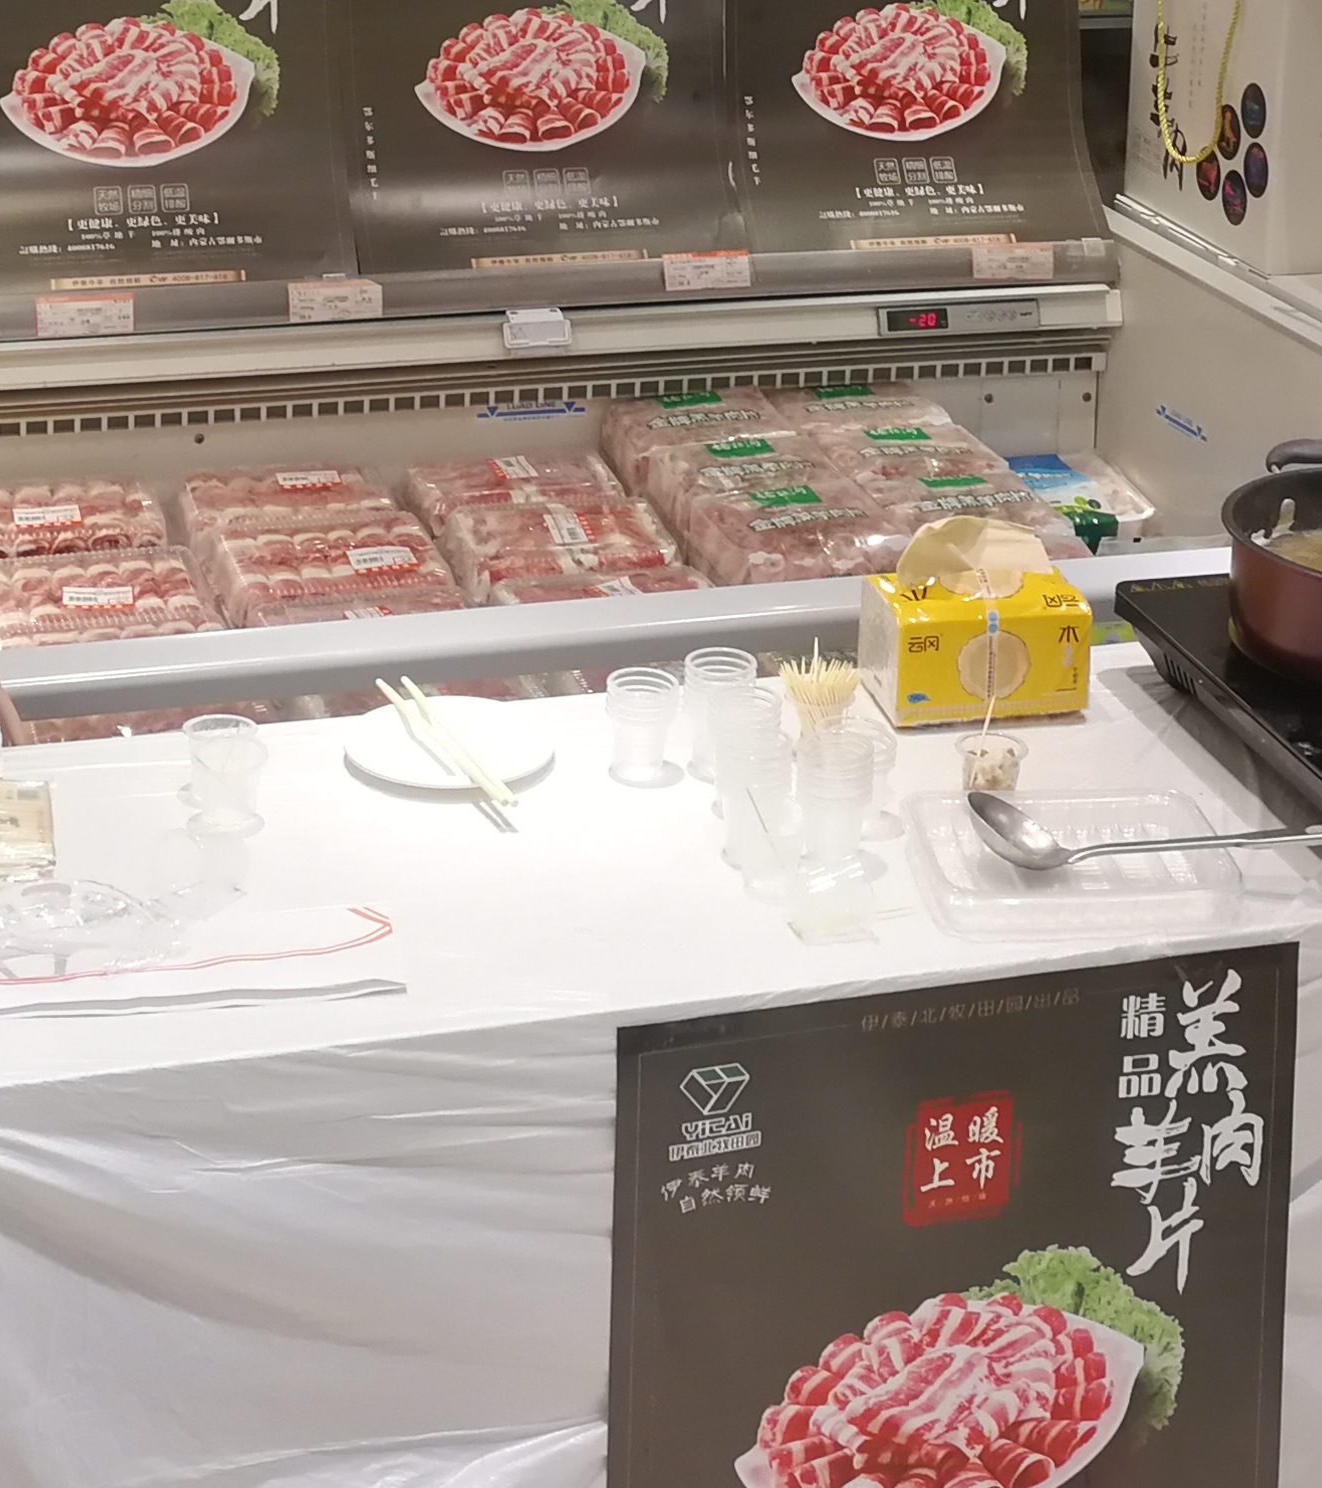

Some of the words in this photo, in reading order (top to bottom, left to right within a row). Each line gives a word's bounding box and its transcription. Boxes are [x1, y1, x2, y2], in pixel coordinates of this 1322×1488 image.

[909, 313, 937, 327] -20
[908, 636, 939, 653] 云冈
[1118, 992, 1166, 1099] 精品
[924, 1106, 1005, 1152] 温暖
[920, 1148, 1002, 1194] 上市
[679, 1183, 772, 1214] 自然领鲜
